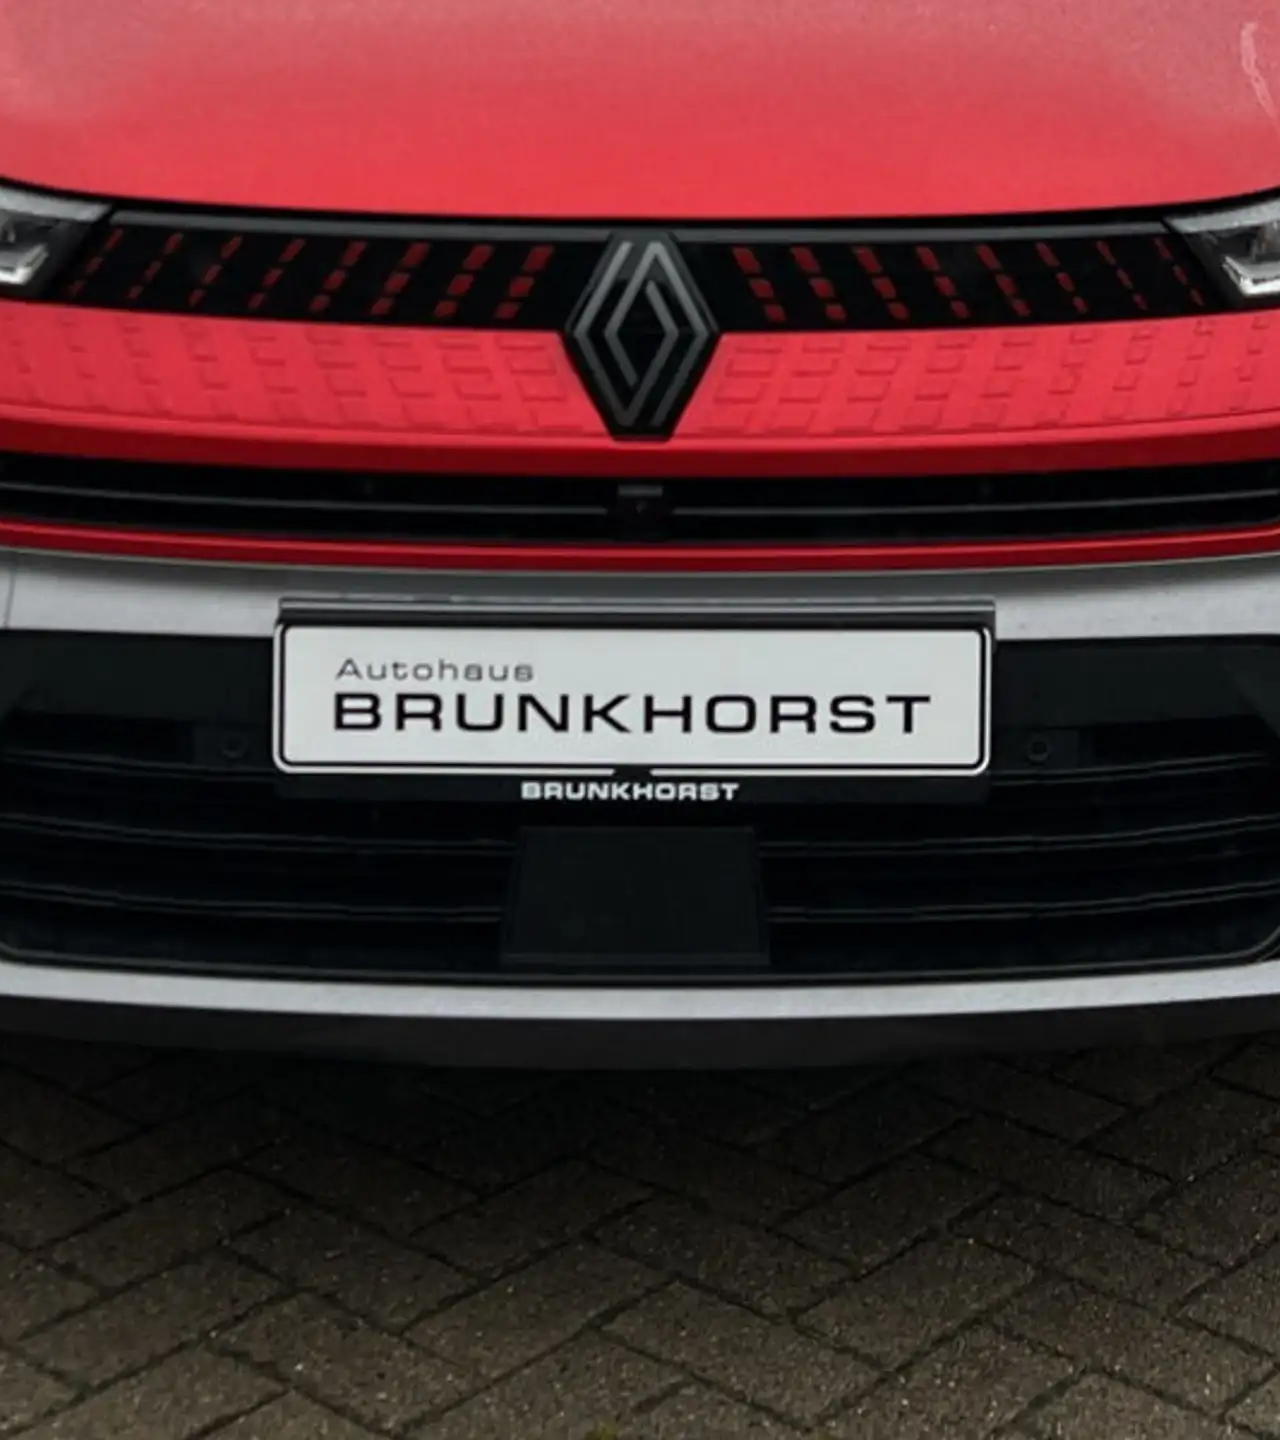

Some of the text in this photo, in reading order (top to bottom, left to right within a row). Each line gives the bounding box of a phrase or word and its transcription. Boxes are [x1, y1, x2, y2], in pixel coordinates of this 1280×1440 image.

[335, 658, 535, 682] Autohaus
[333, 692, 932, 734] BRUNKHORST
[520, 780, 740, 801] BRUNKHORST
